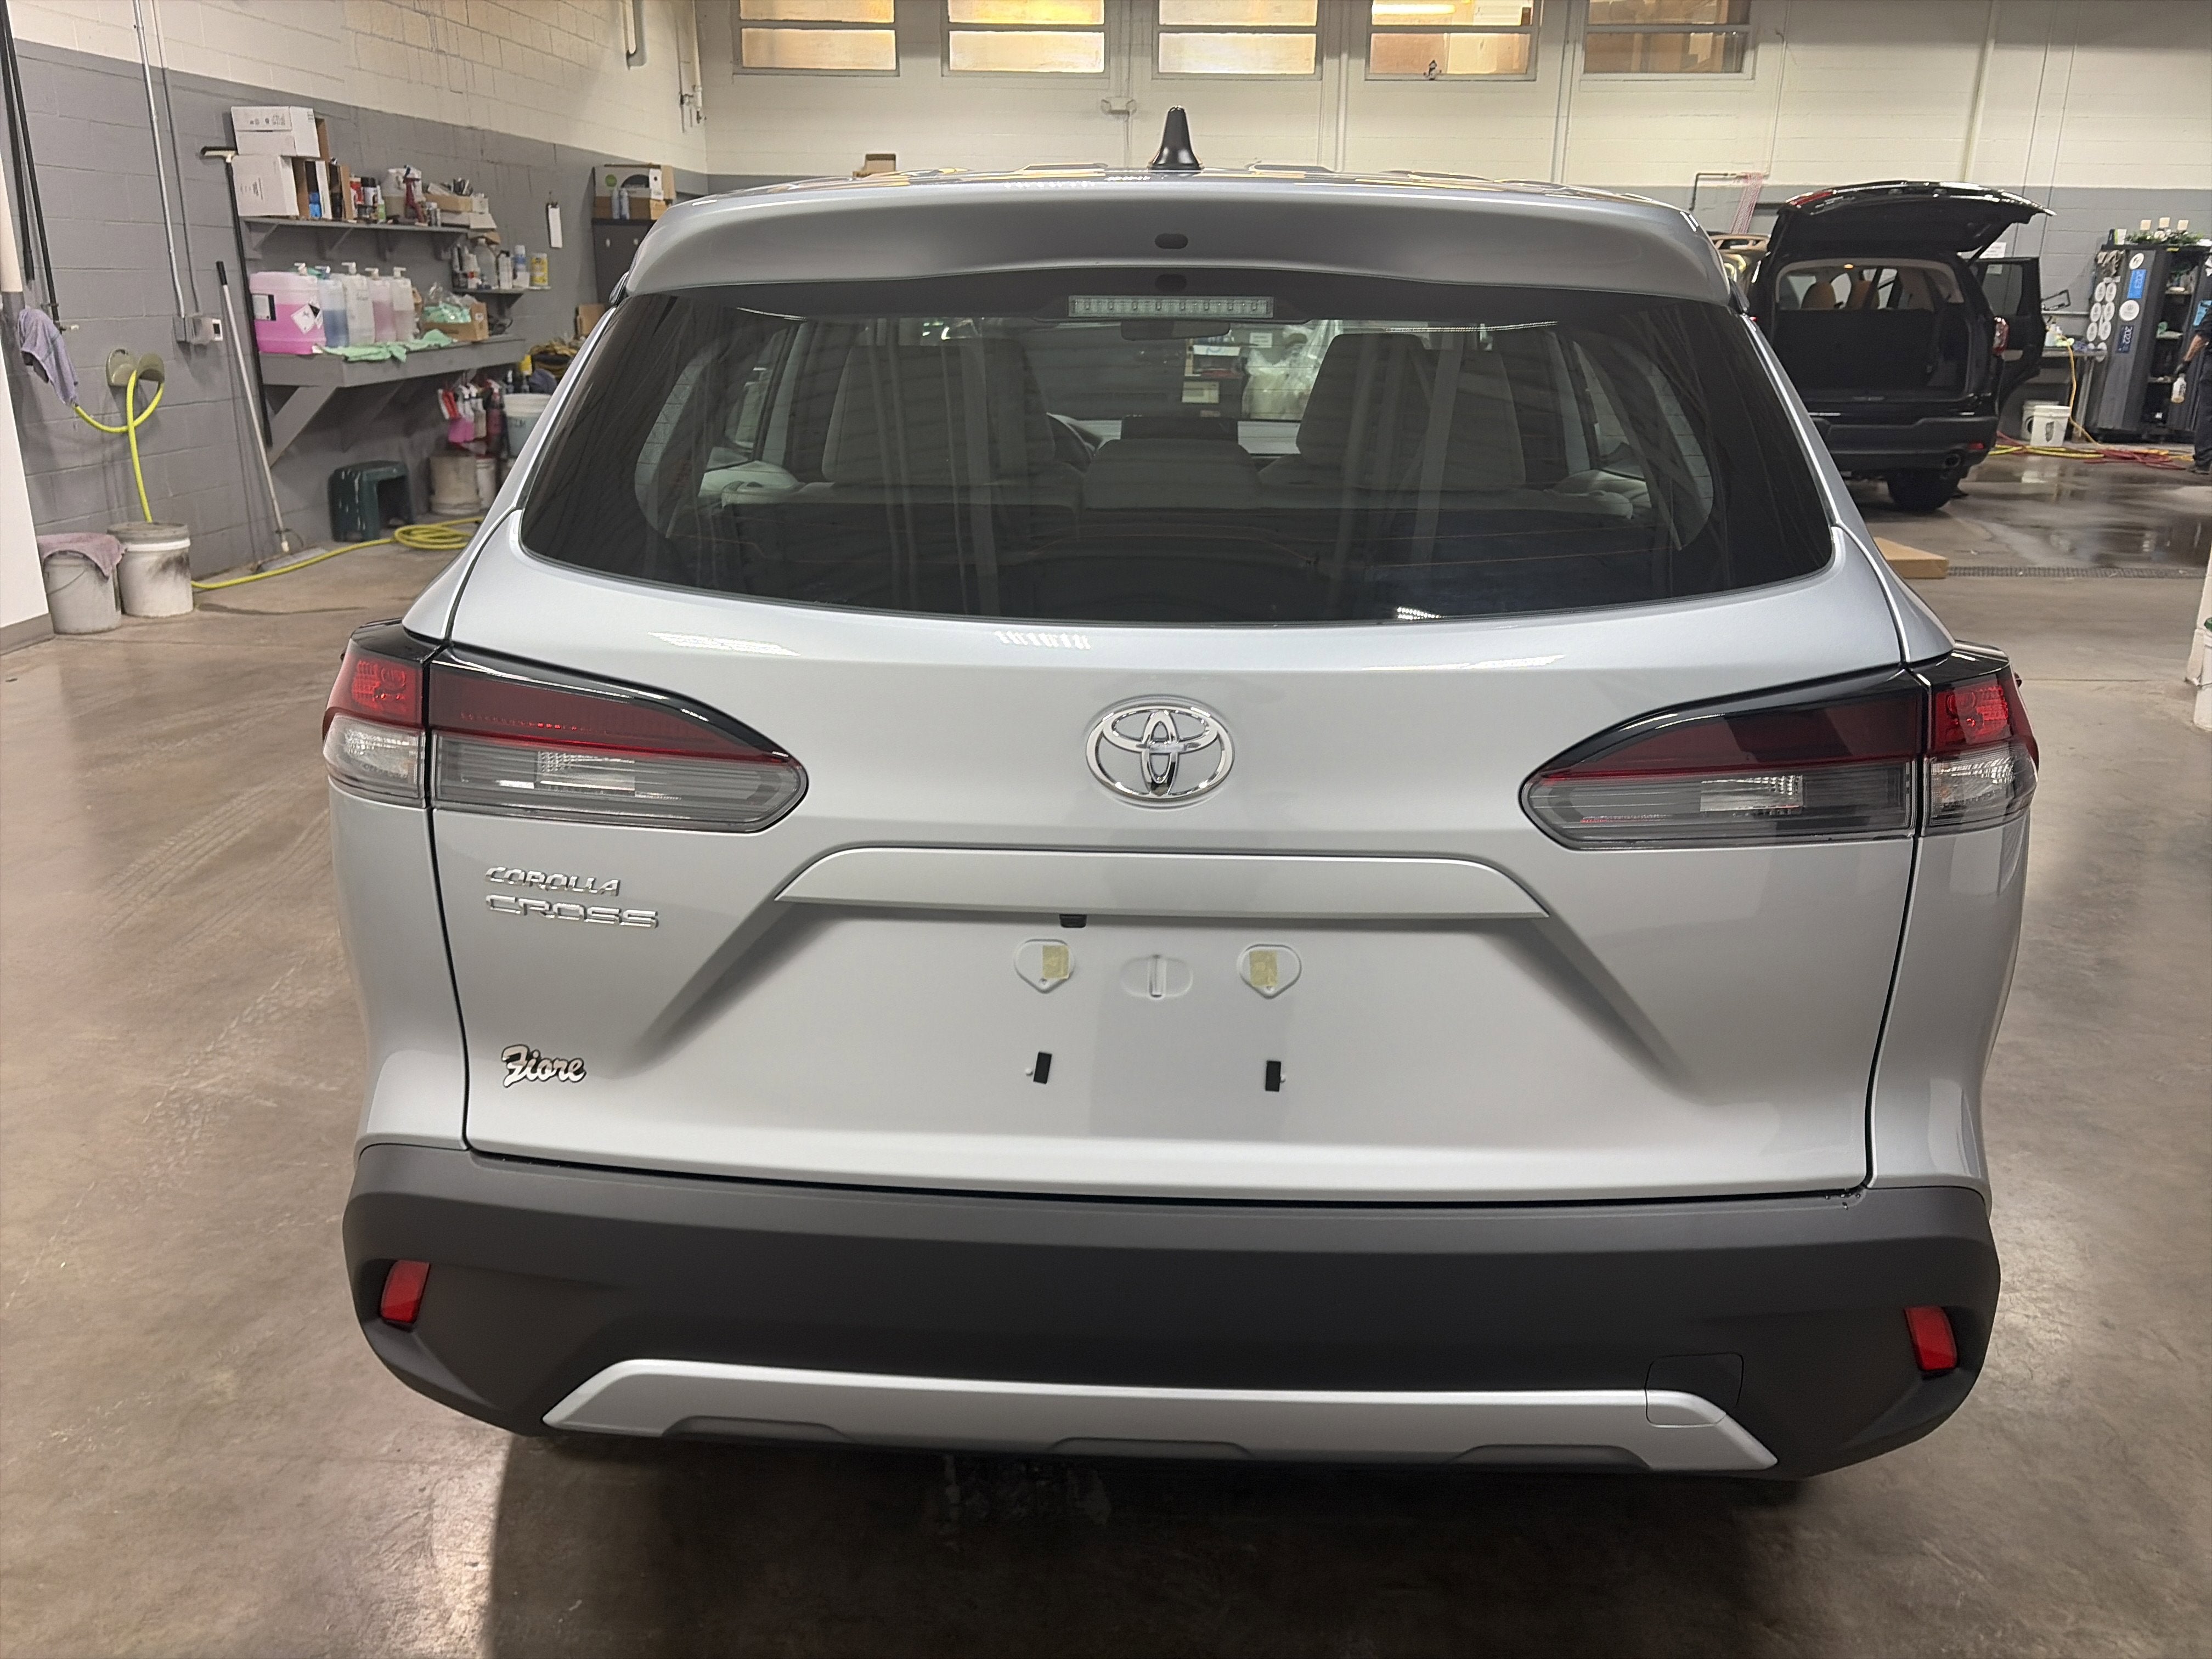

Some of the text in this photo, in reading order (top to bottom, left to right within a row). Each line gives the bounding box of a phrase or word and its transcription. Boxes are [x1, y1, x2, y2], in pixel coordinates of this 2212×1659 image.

[2123, 326, 2133, 345] 2022
[486, 867, 620, 896] COROLLA
[486, 894, 658, 928] CROSS
[501, 1044, 586, 1088] Fiore
